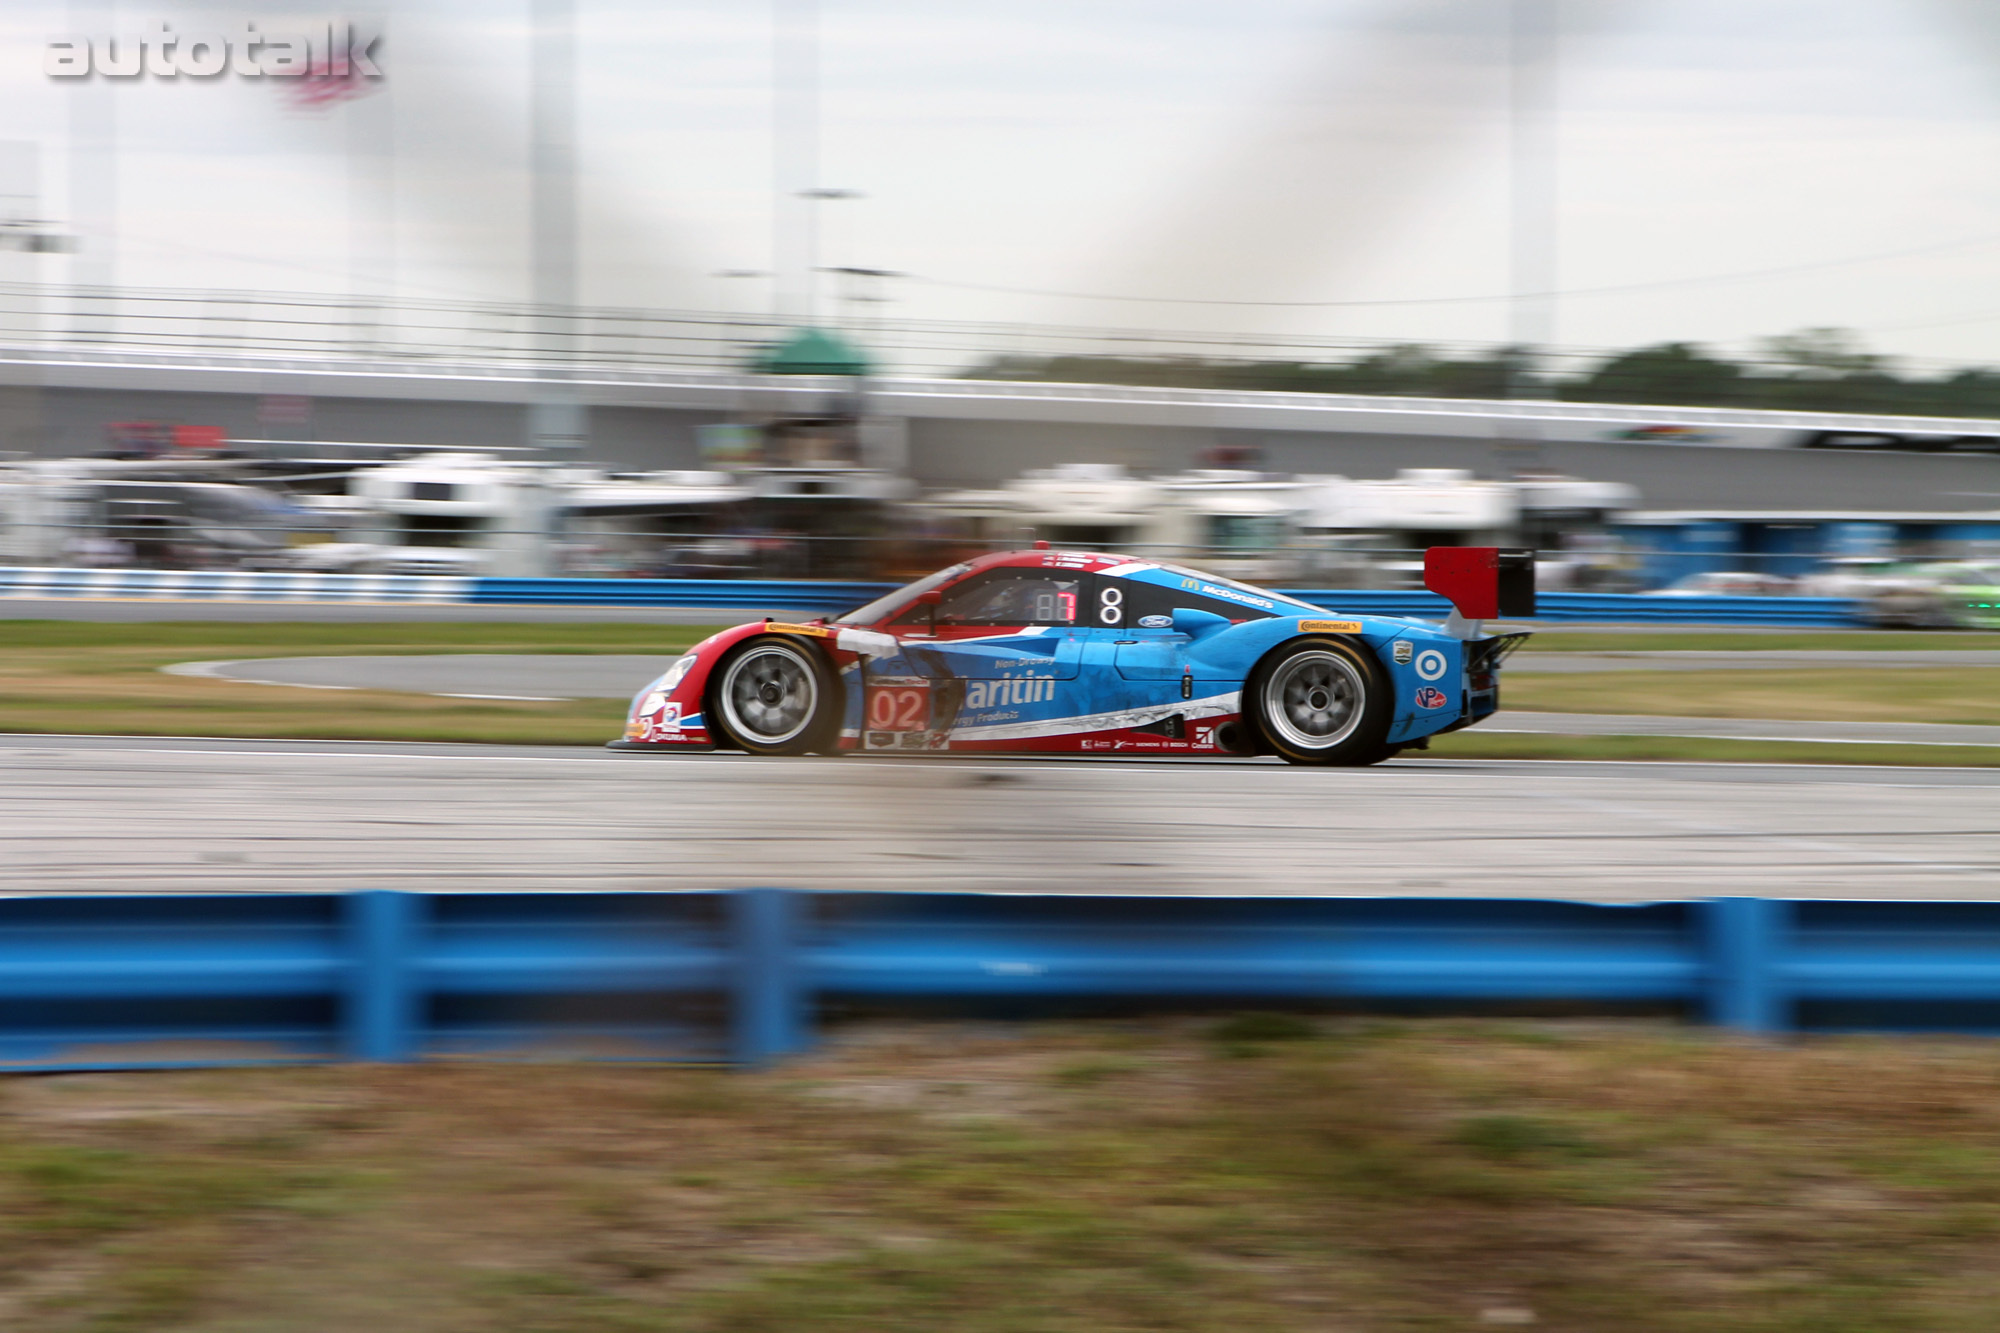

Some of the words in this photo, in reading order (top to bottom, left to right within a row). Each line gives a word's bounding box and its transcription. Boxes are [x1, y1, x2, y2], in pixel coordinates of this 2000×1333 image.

[1202, 584, 1275, 609] McDonald's
[1300, 620, 1350, 632] Continental
[872, 690, 923, 728] 02
